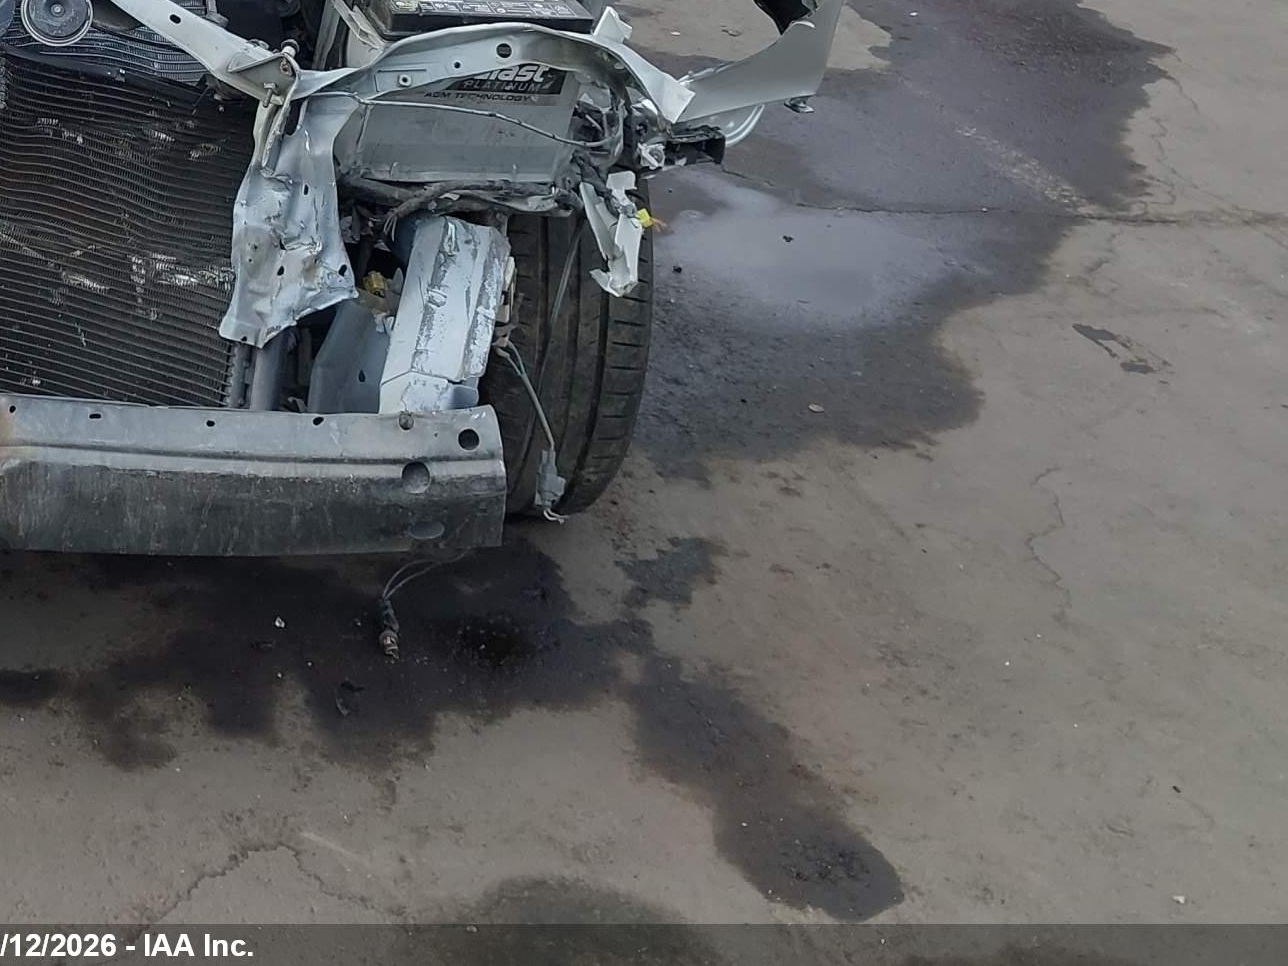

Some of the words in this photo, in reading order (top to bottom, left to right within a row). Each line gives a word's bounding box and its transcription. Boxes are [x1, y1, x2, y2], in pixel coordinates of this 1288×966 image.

[463, 80, 541, 92] PLATINUM
[424, 91, 451, 99] AGM
[455, 92, 532, 102] TECHNOLOGY
